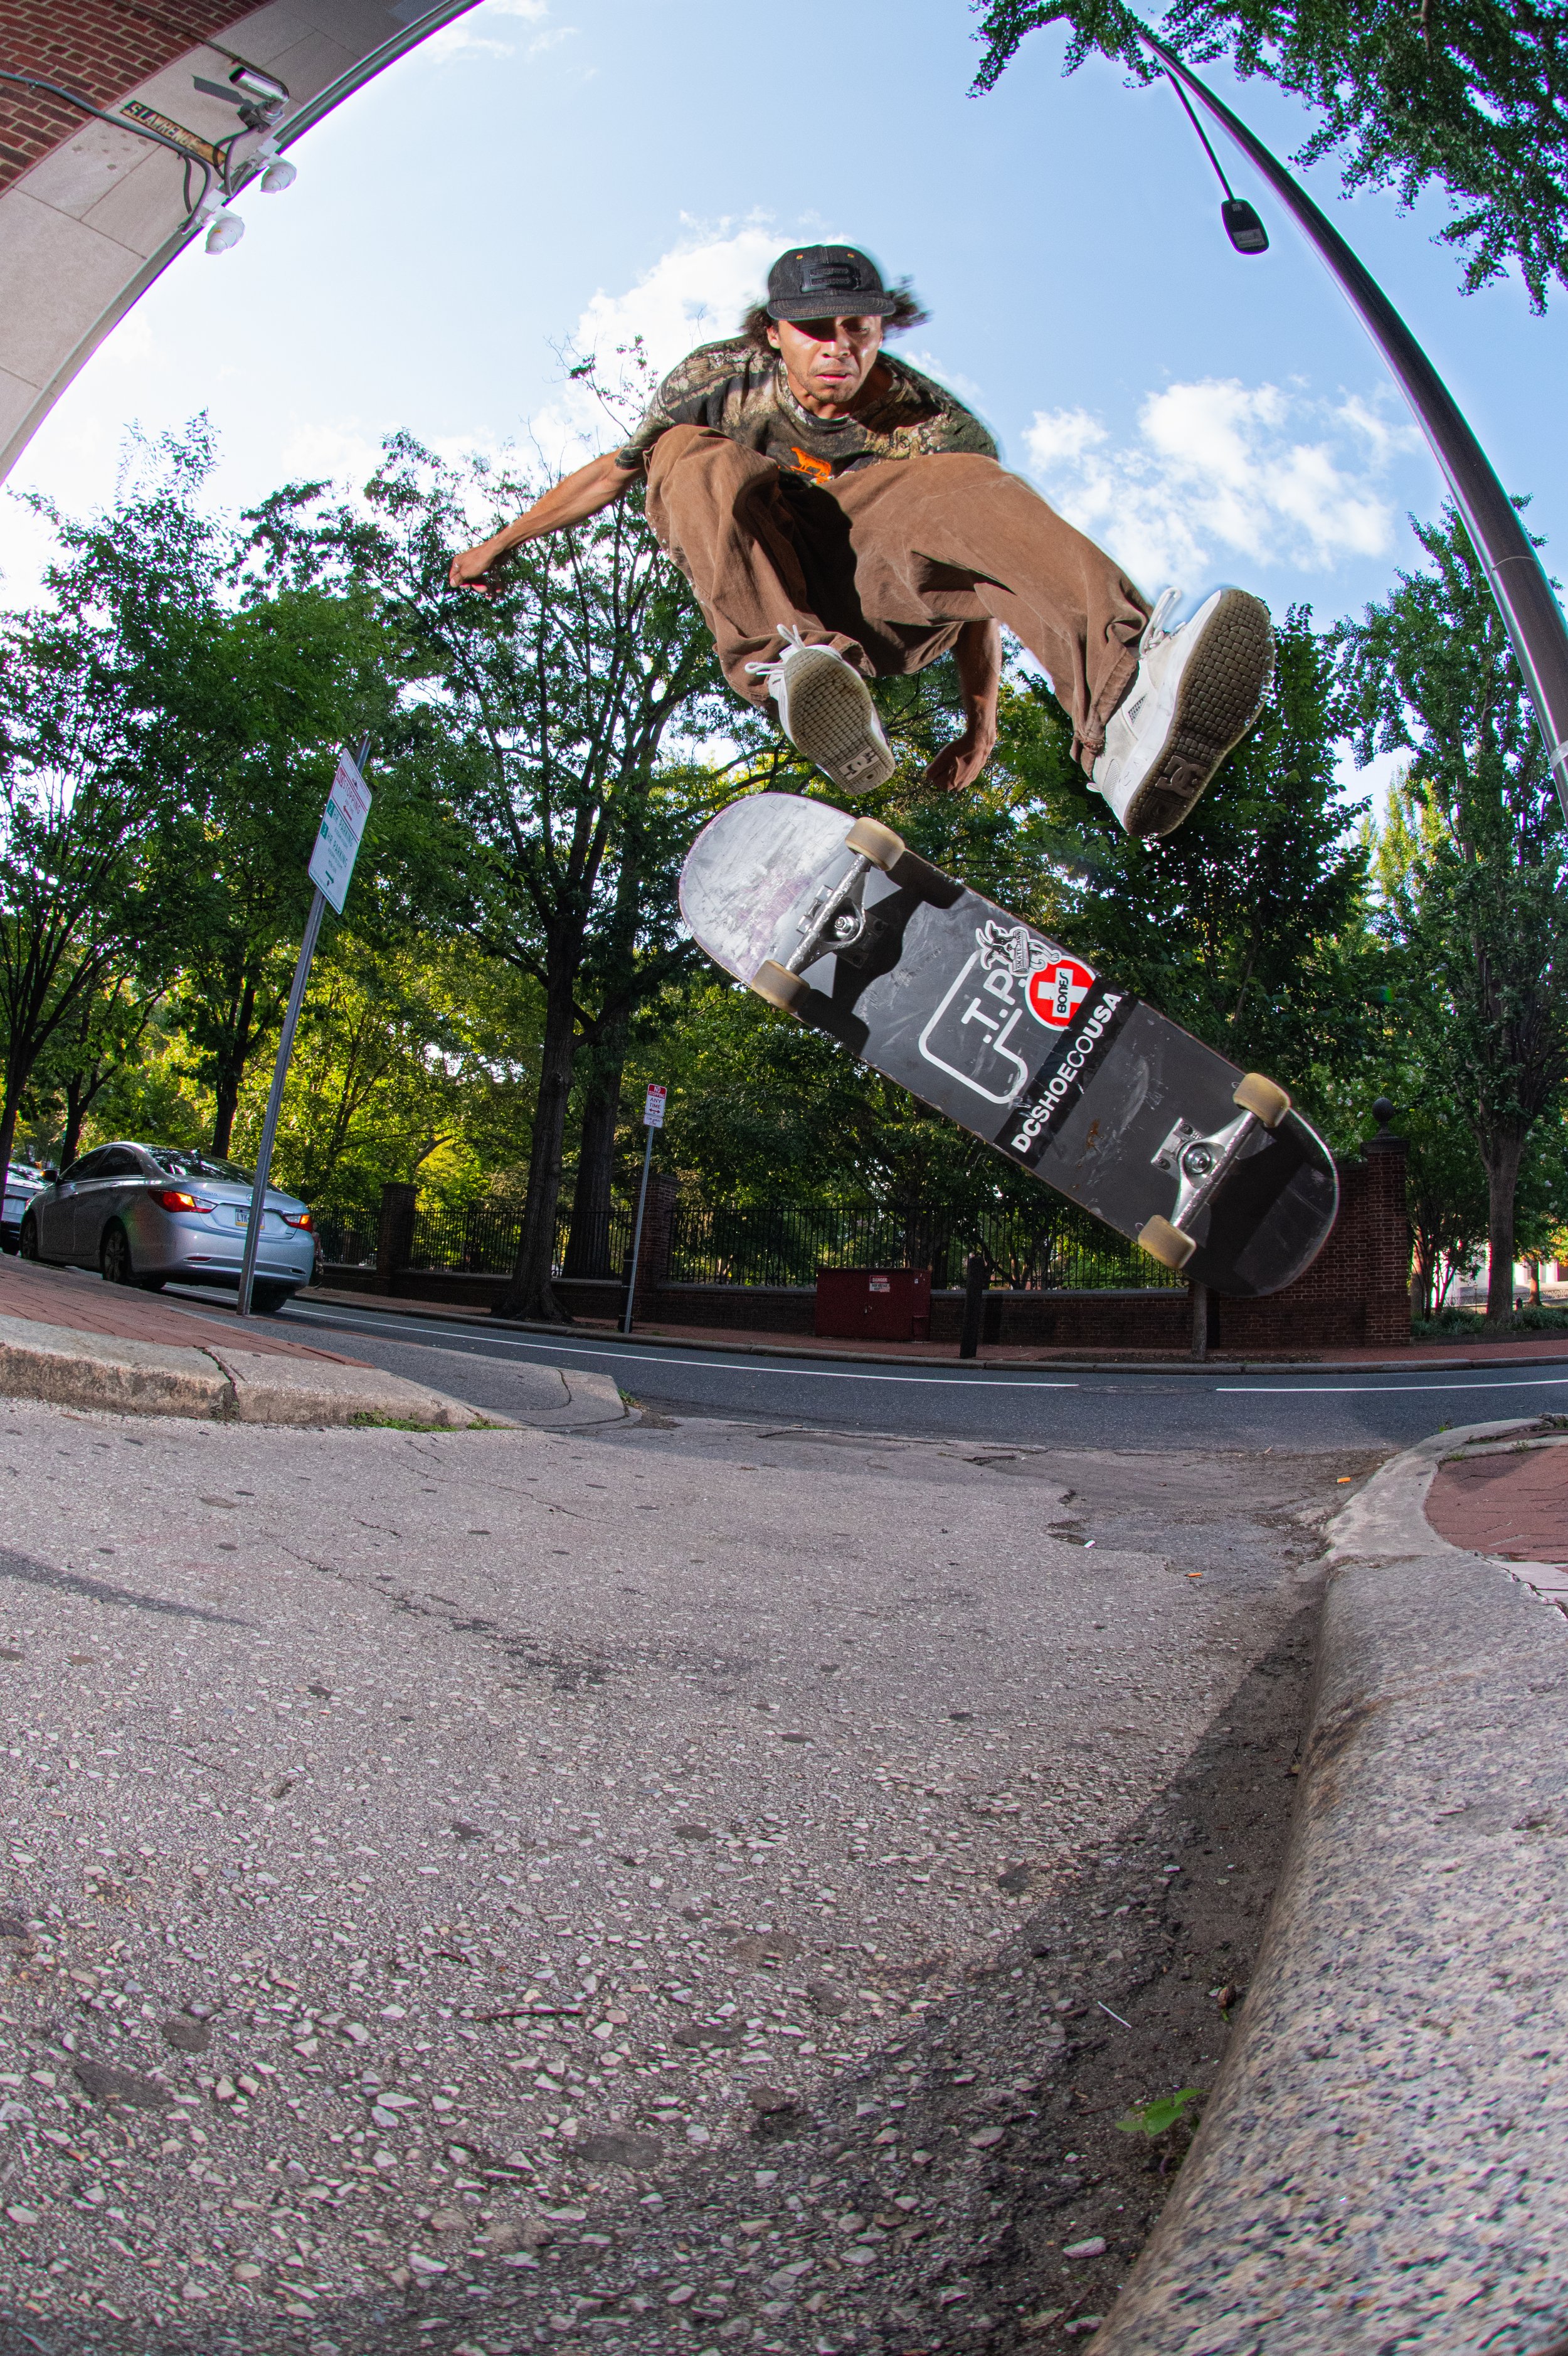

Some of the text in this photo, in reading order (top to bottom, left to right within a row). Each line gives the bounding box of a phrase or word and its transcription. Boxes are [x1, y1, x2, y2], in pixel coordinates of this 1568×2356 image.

[337, 768, 344, 787] NO
[342, 779, 361, 815] STOPPING
[322, 824, 327, 837] 3
[326, 830, 333, 846] HR
[332, 840, 348, 869] PARKING
[328, 802, 333, 814] 2
[332, 809, 339, 825] HR
[337, 819, 354, 847] PARKING
[1057, 971, 1069, 1014] BONES
[649, 1090, 665, 1098] STOPPING
[1010, 993, 1123, 1153] DCSHOECOUSA
